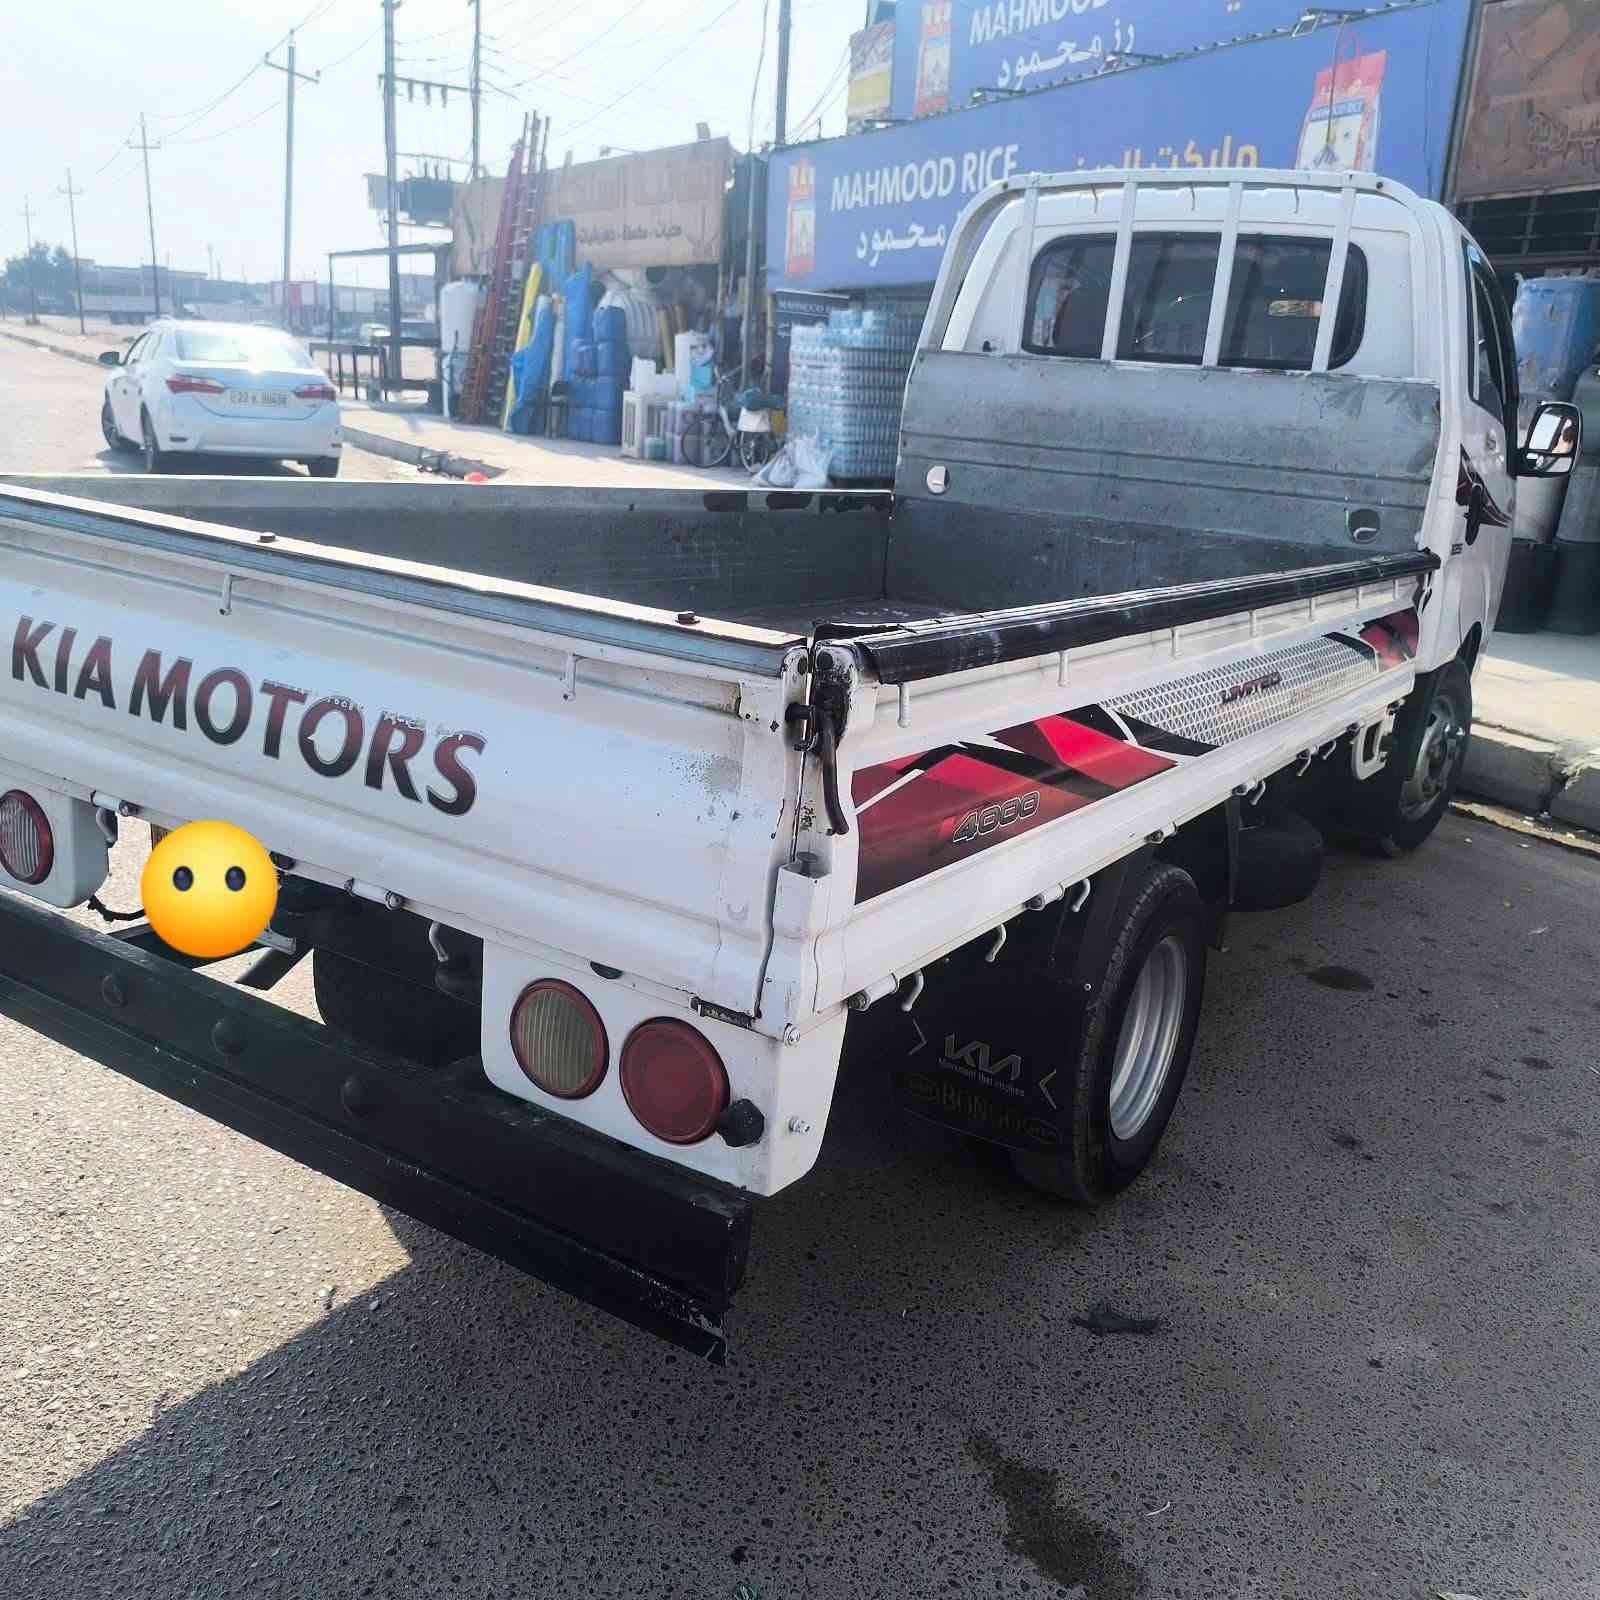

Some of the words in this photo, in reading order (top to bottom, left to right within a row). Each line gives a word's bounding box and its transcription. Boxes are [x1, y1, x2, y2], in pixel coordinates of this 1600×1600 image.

[969, 0, 1110, 47] MAHMO
[1112, 17, 1136, 54] رز
[997, 34, 1103, 91] محمود
[831, 156, 956, 213] MAHMOOD
[961, 143, 1019, 194] RICE
[856, 222, 947, 268] محمود
[11, 615, 117, 710] KIA
[128, 647, 488, 817] MOTORS
[952, 790, 1041, 844] 4000
